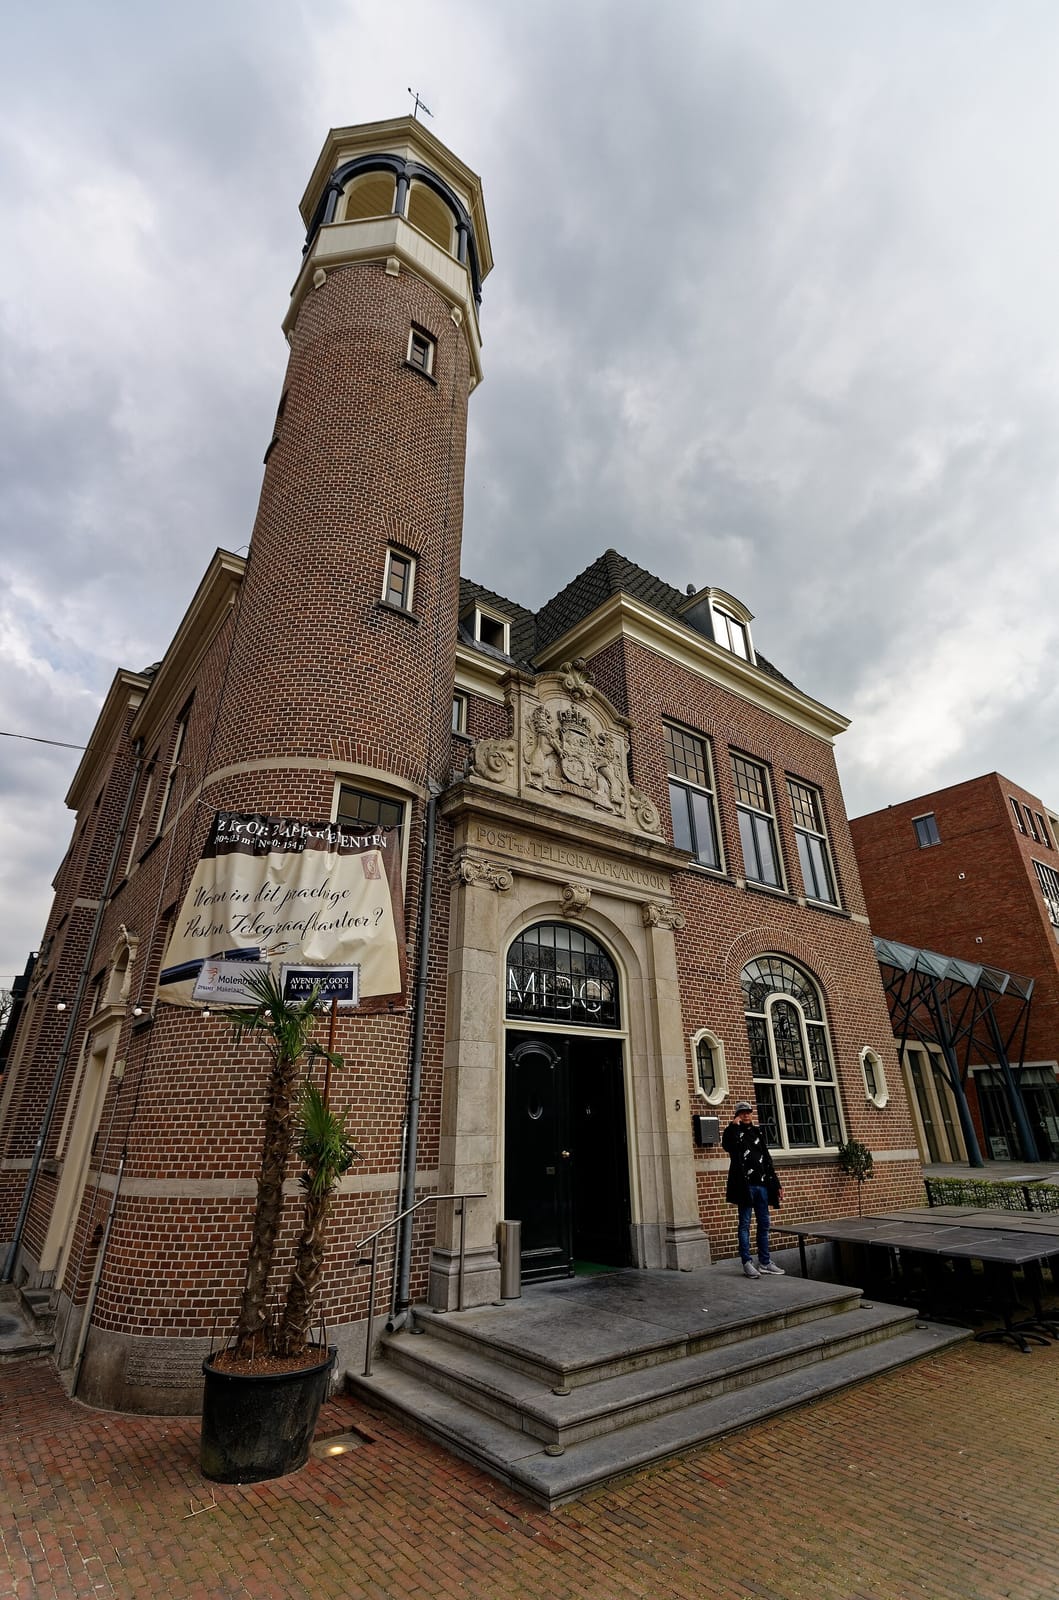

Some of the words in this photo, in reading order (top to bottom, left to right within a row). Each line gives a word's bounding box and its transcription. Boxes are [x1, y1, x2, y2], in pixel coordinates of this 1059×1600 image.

[477, 826, 516, 851] POST
[530, 841, 666, 890] TELEGRAAFKANTOOR
[230, 889, 250, 902] in
[254, 881, 281, 903] dit
[273, 878, 351, 914] prachige
[329, 977, 349, 985] GOOI
[675, 1099, 681, 1111] 5
